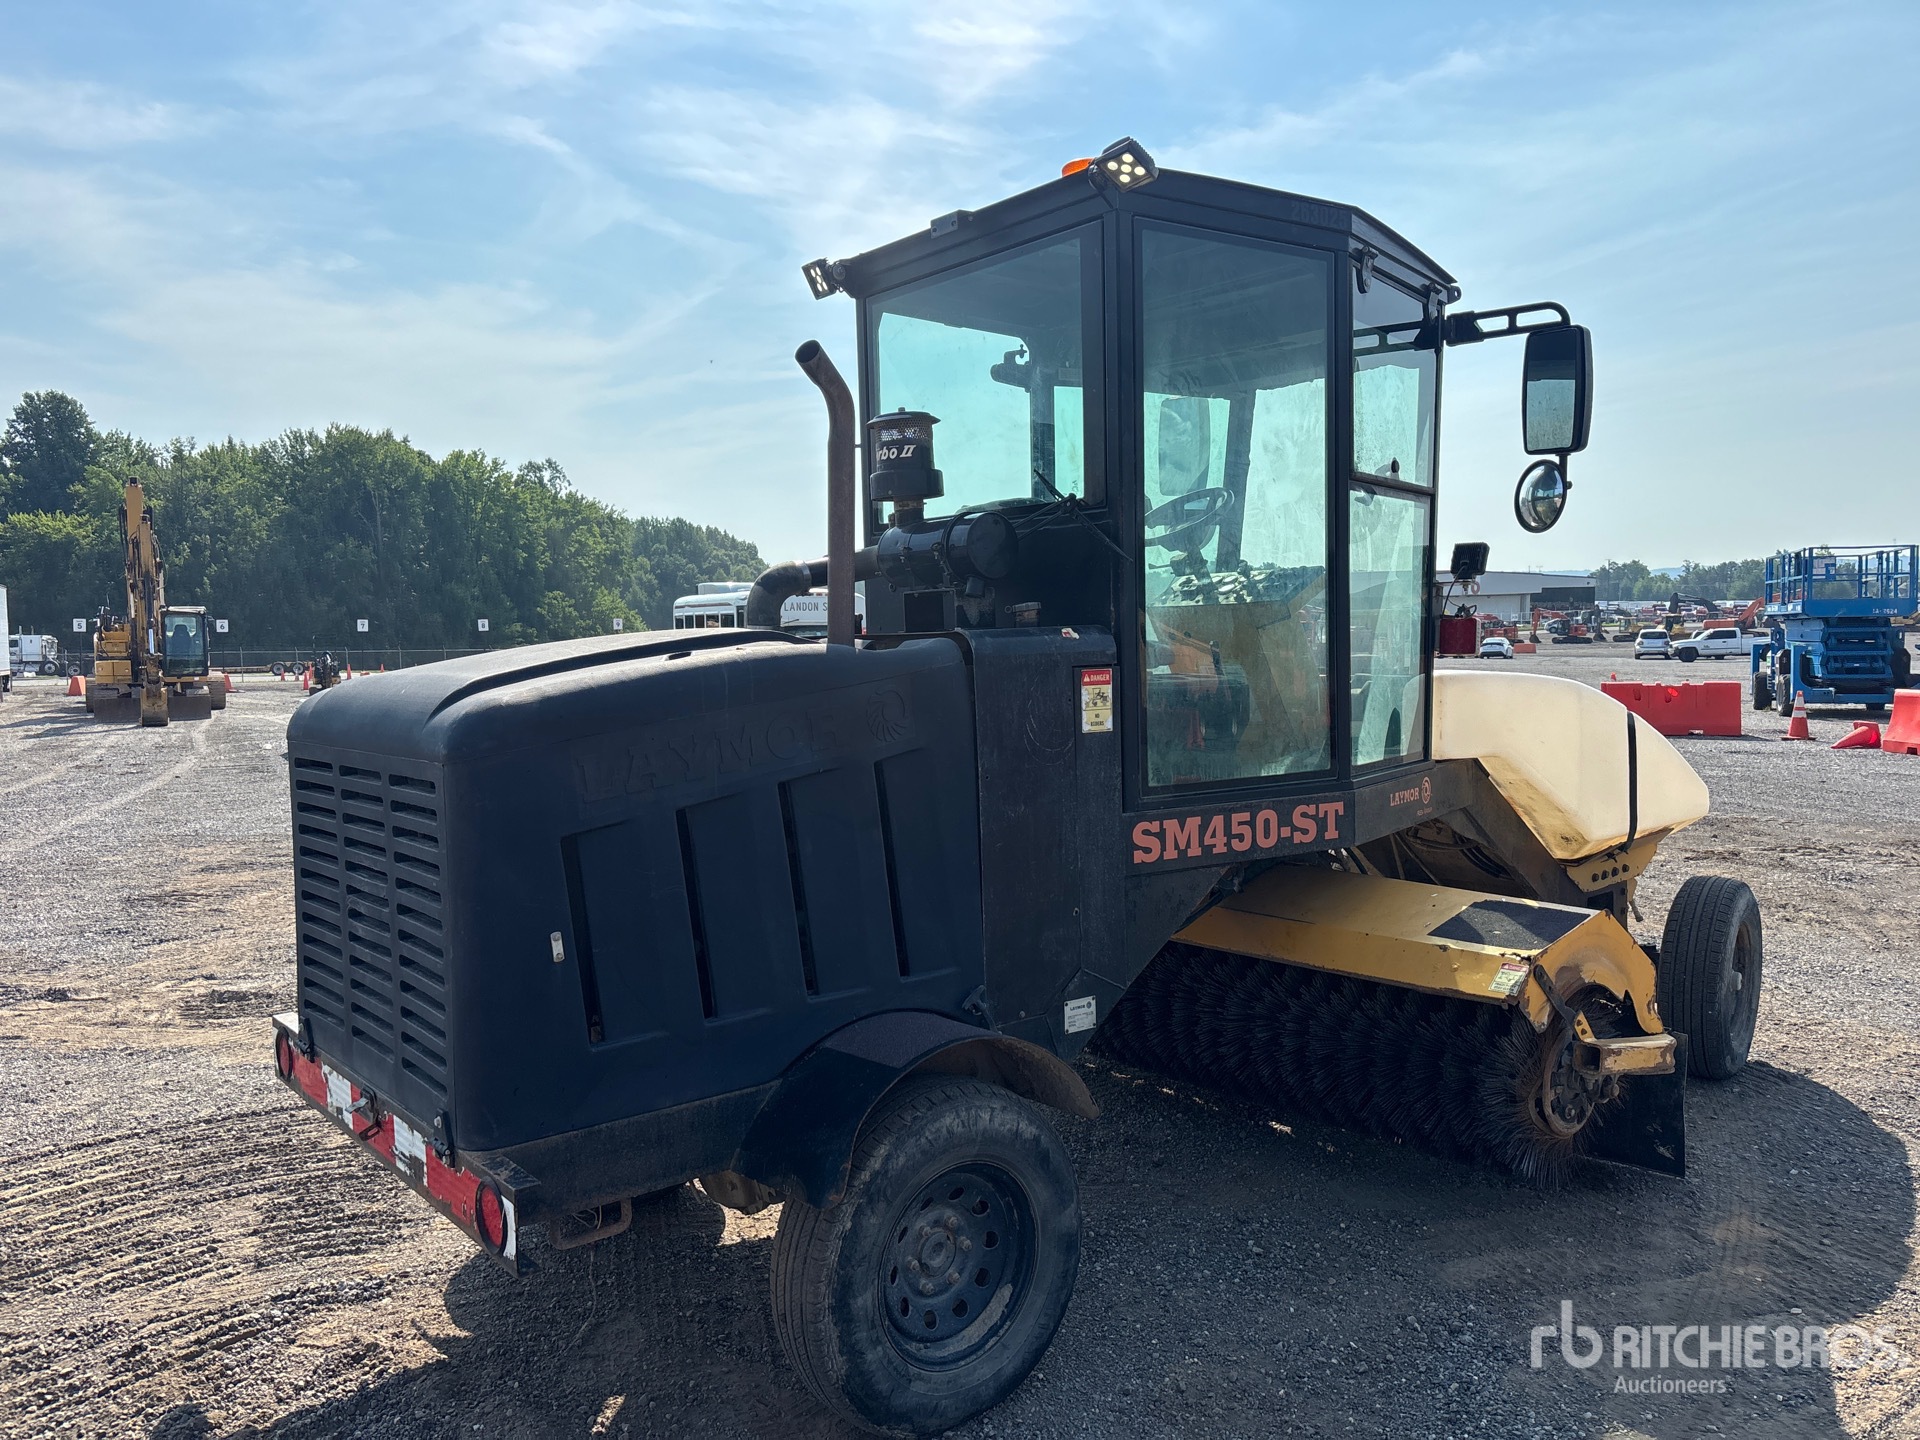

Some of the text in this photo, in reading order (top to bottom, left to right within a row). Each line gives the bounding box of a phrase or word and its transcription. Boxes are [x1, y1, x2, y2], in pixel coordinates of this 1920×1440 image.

[784, 602, 819, 612] LANDON
[1090, 674, 1110, 682] DANGER
[1390, 787, 1420, 807] LAYMOR
[1132, 801, 1344, 864] SM450-ST
